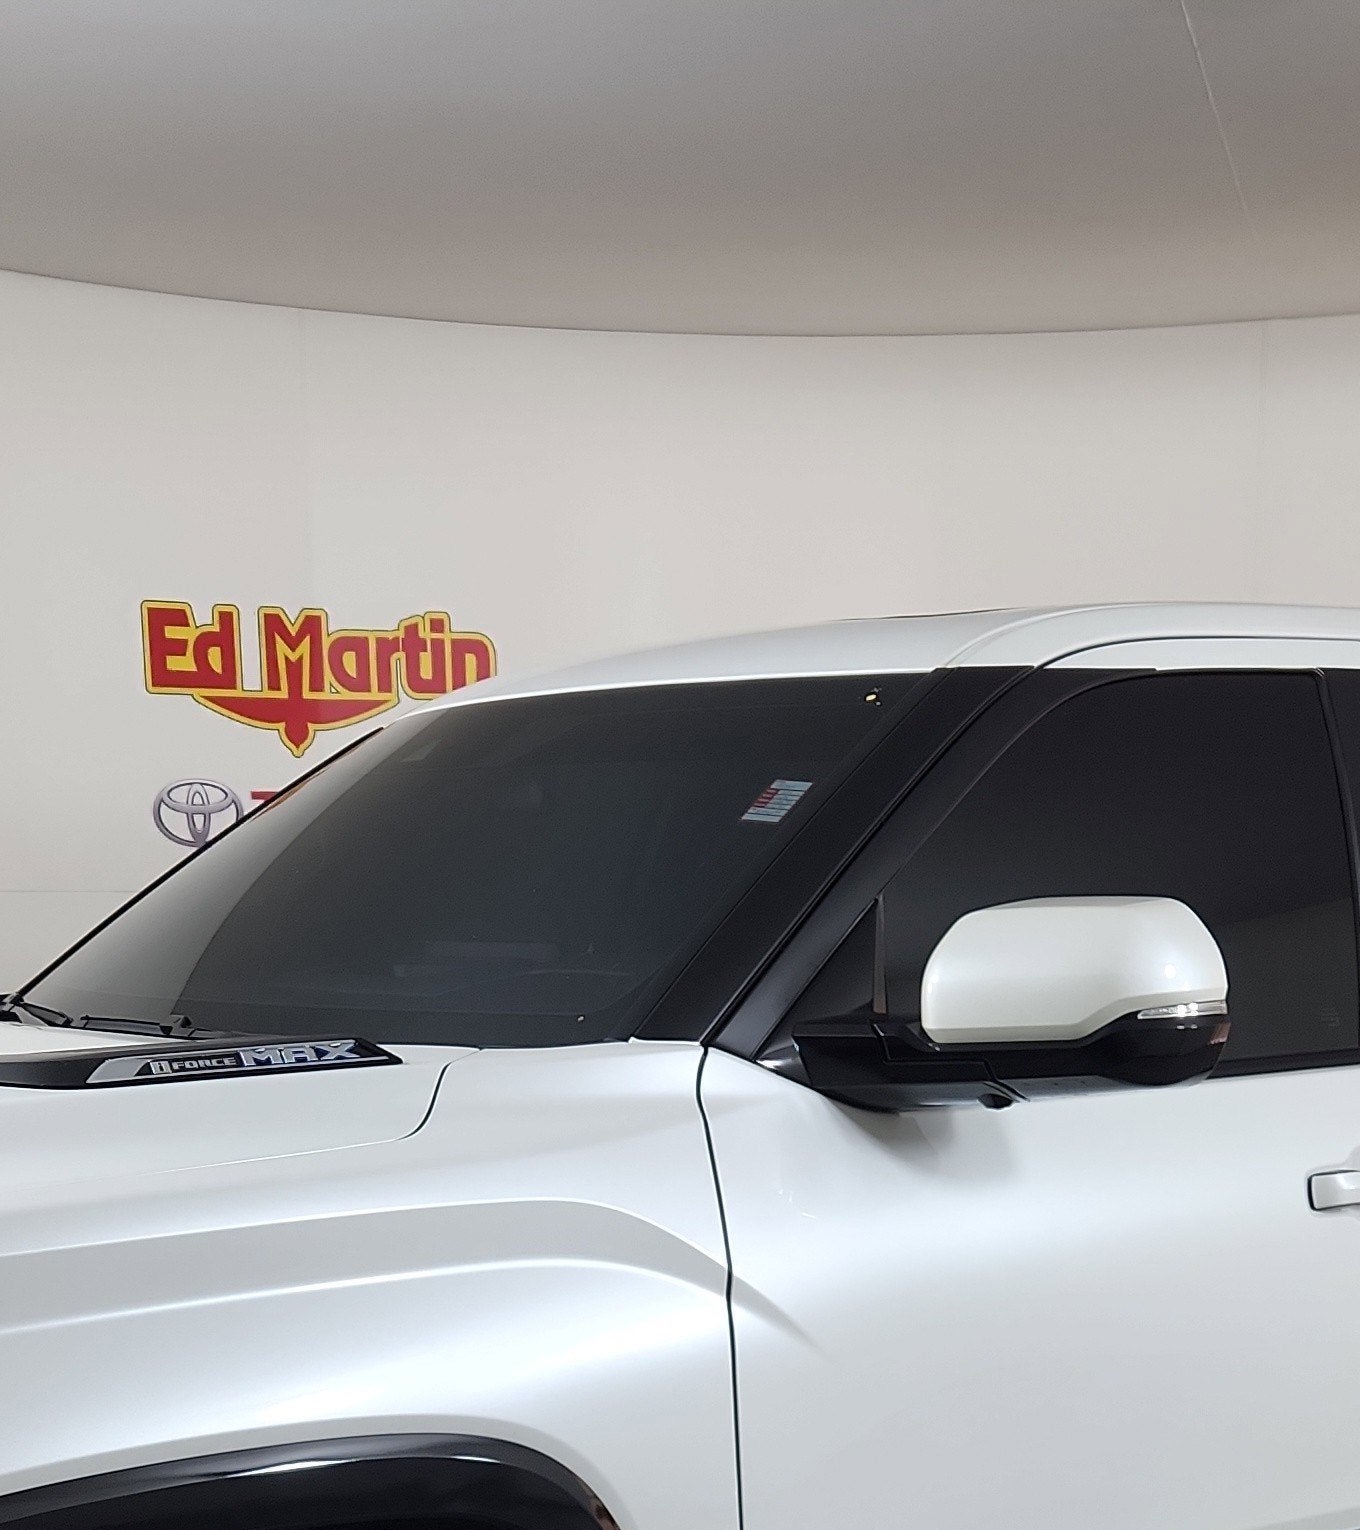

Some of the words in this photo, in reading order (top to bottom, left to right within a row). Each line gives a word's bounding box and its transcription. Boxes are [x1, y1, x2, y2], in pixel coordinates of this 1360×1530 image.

[145, 605, 240, 691] Ed
[261, 610, 492, 695] Martin
[239, 1040, 361, 1067] MAX
